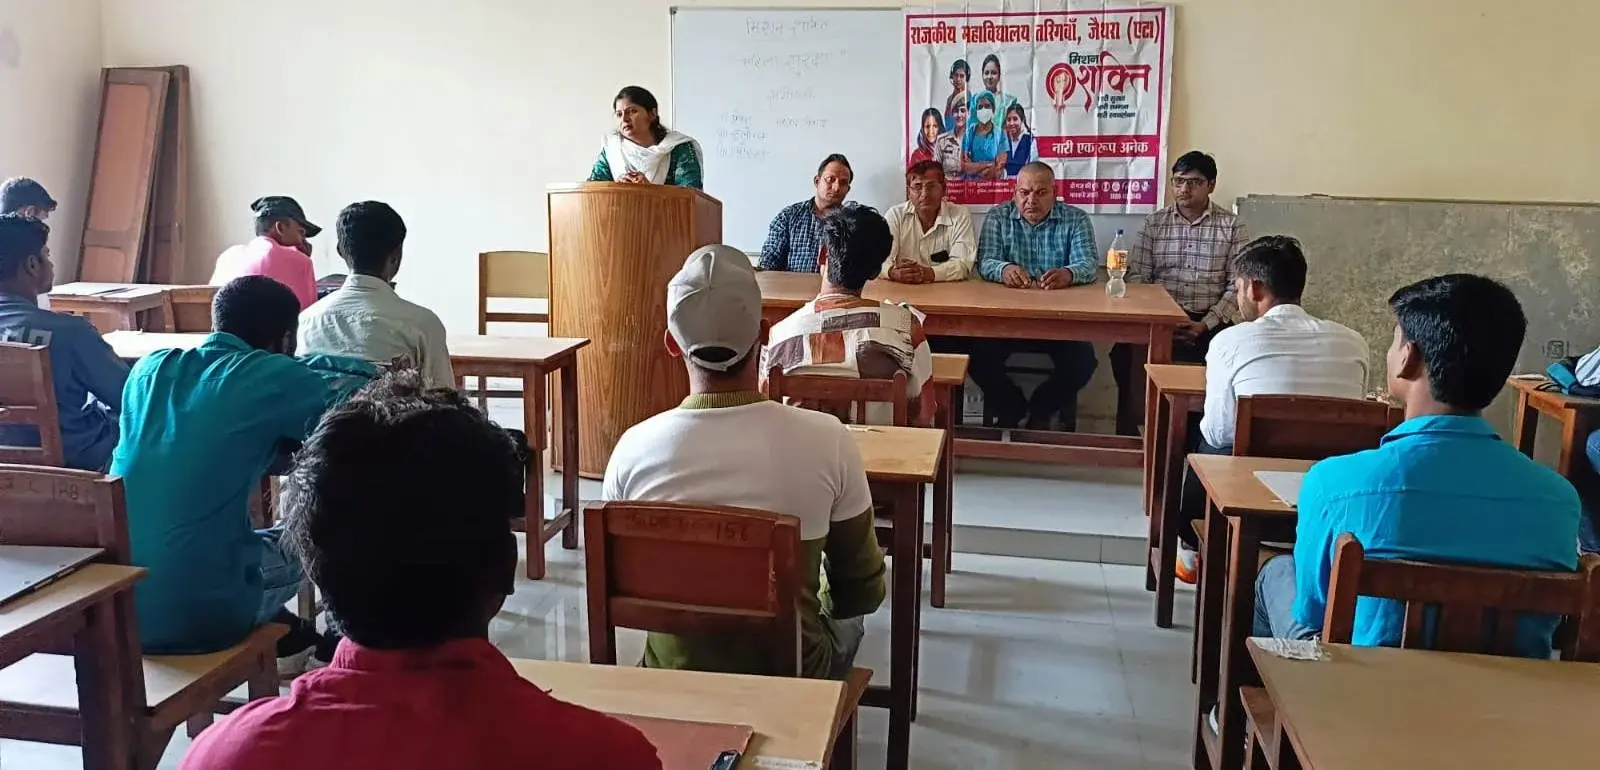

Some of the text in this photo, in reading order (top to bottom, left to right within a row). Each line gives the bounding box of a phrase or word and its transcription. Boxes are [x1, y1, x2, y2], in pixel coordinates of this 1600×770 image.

[911, 21, 956, 44] राजकीय
[962, 20, 1030, 43] महाविद्यालय
[1088, 16, 1120, 39] जैथरा
[1127, 15, 1160, 44] (एटा)
[1068, 52, 1099, 64] मिशन
[1077, 51, 1152, 113] शक्ति
[1052, 139, 1149, 154] नारी एक रूप अनेक
